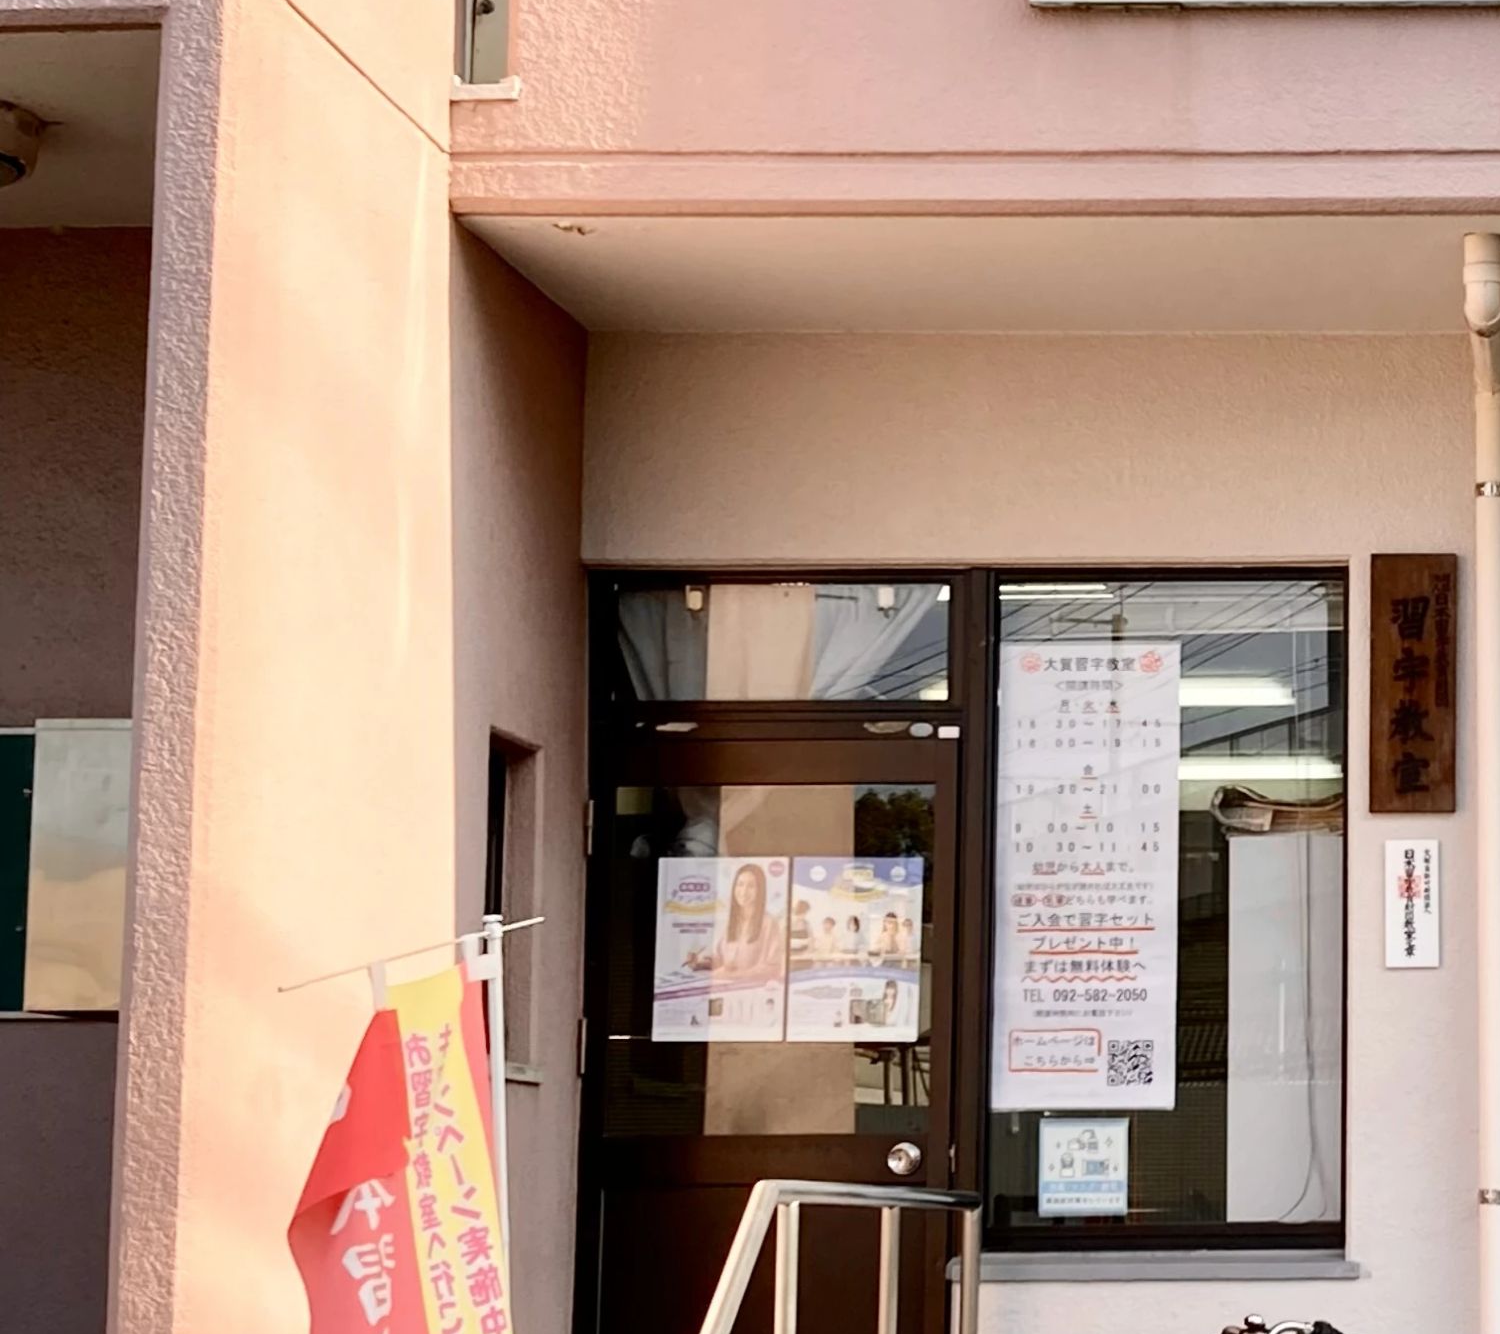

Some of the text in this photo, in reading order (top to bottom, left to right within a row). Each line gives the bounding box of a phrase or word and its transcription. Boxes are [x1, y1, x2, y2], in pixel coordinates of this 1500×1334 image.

[1043, 657, 1136, 672] 大賀習字教室
[1387, 596, 1435, 795] 習字教室
[1017, 913, 1154, 927] ご入会で習字セット
[1024, 959, 1146, 973] まずは無料体験へ
[1023, 988, 1148, 1003] TEL 092-582-2050
